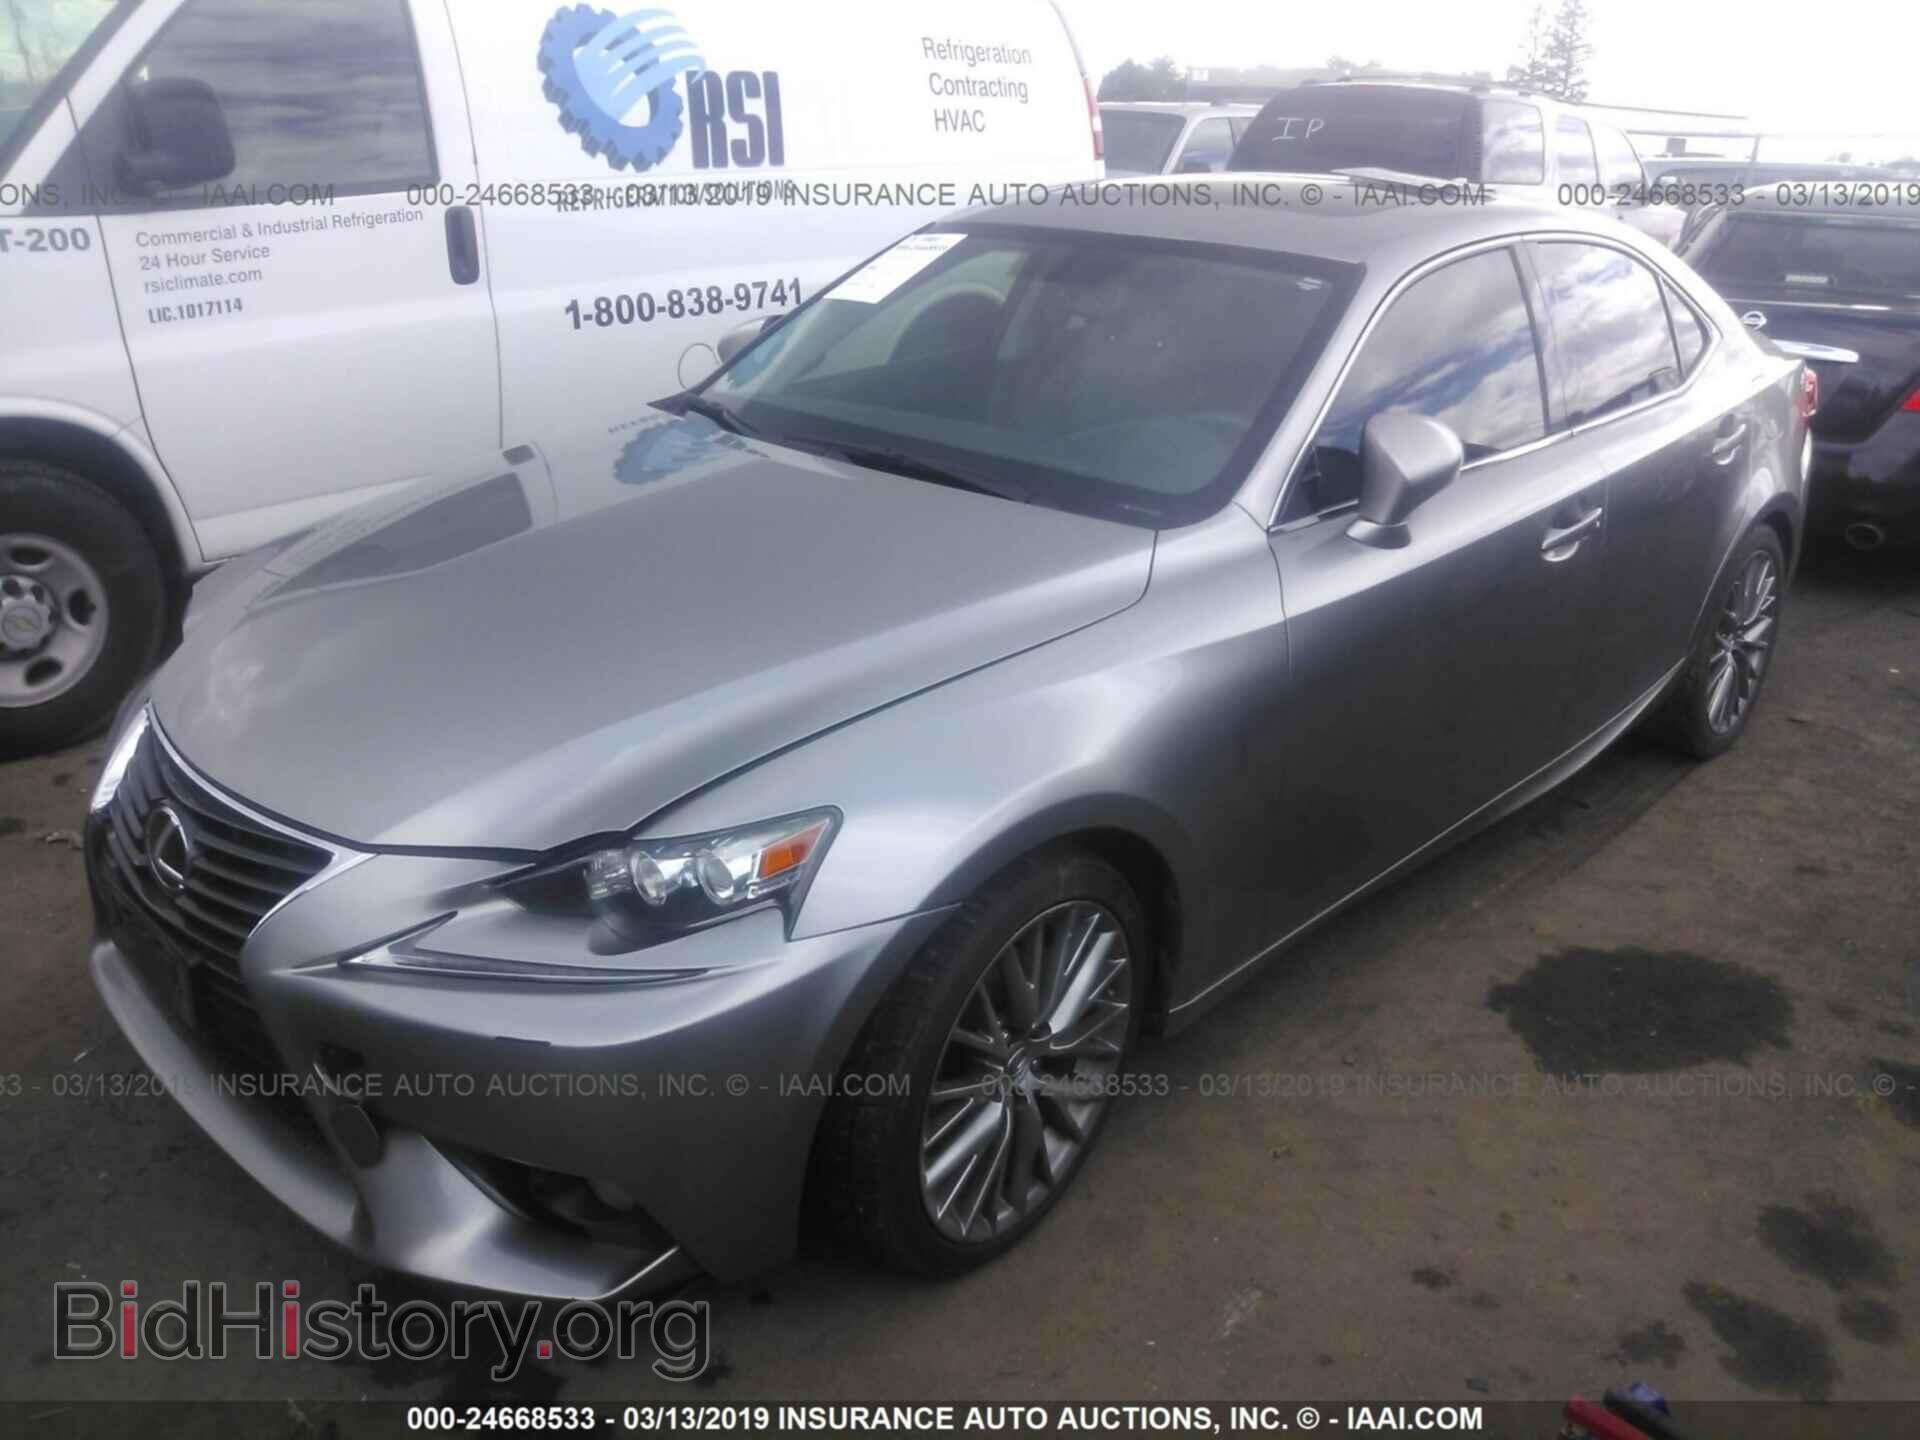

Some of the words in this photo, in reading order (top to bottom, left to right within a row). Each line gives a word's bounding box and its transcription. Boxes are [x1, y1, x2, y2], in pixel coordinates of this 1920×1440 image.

[921, 36, 1032, 67] Refrigeration
[929, 72, 1029, 104] Contracting
[685, 70, 785, 169] RSI
[934, 108, 986, 133] HVAC
[136, 224, 237, 247] Commercial
[242, 223, 254, 238] &
[257, 216, 328, 237] Industrial
[331, 208, 423, 229] Refrigeration
[140, 255, 161, 270] 24
[166, 250, 206, 267] Hour
[212, 245, 270, 264] Service
[144, 269, 263, 294] rsiclimate.com
[148, 298, 243, 323] LIC.1017114
[565, 277, 801, 329] 1-800-838-9741
